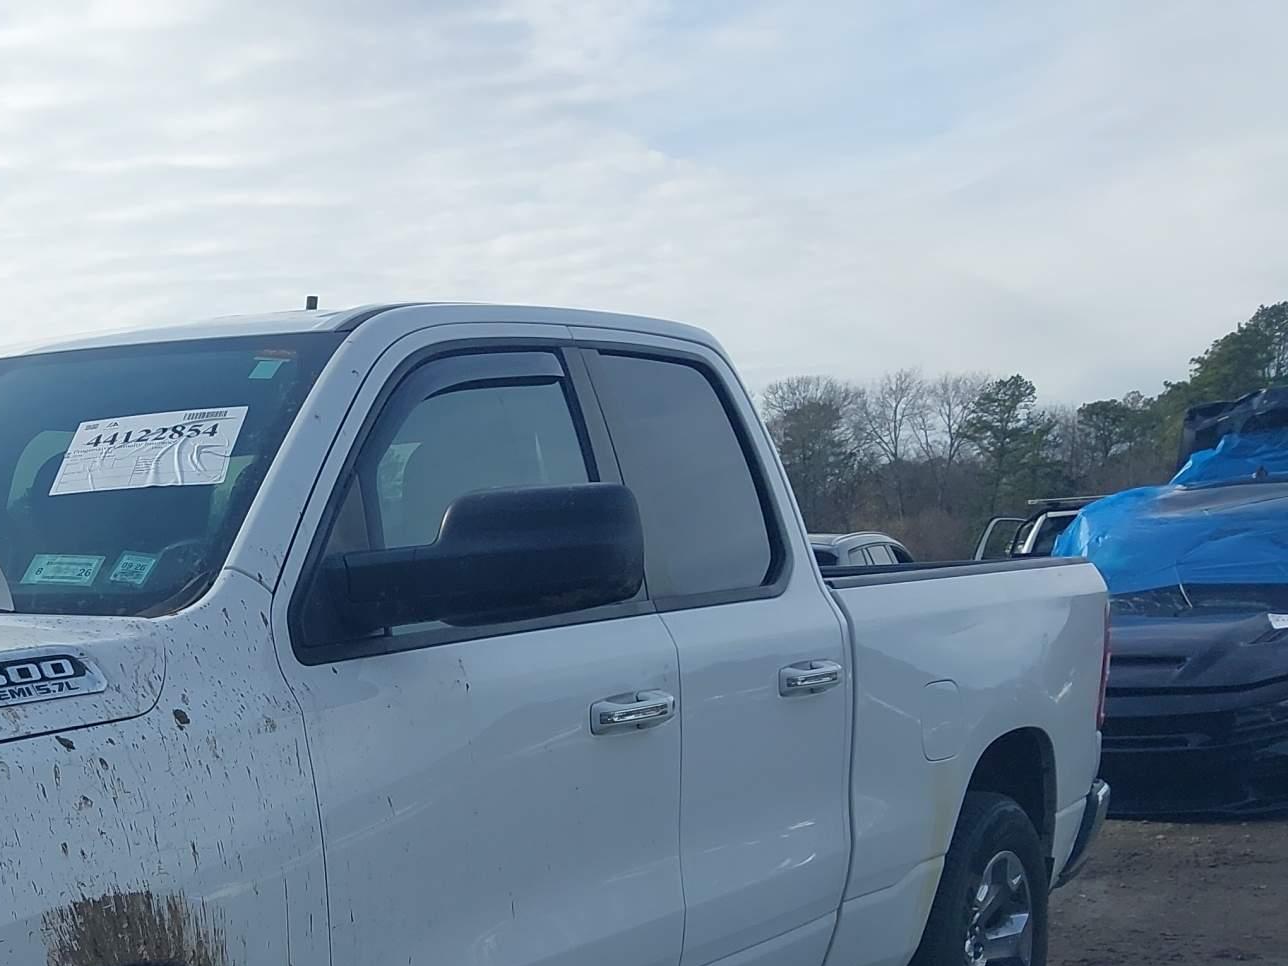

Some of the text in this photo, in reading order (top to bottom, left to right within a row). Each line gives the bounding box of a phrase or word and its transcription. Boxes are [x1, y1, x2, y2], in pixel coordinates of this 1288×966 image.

[85, 422, 220, 448] 44122854
[77, 568, 92, 578] 26
[35, 681, 80, 696] 5.7L
